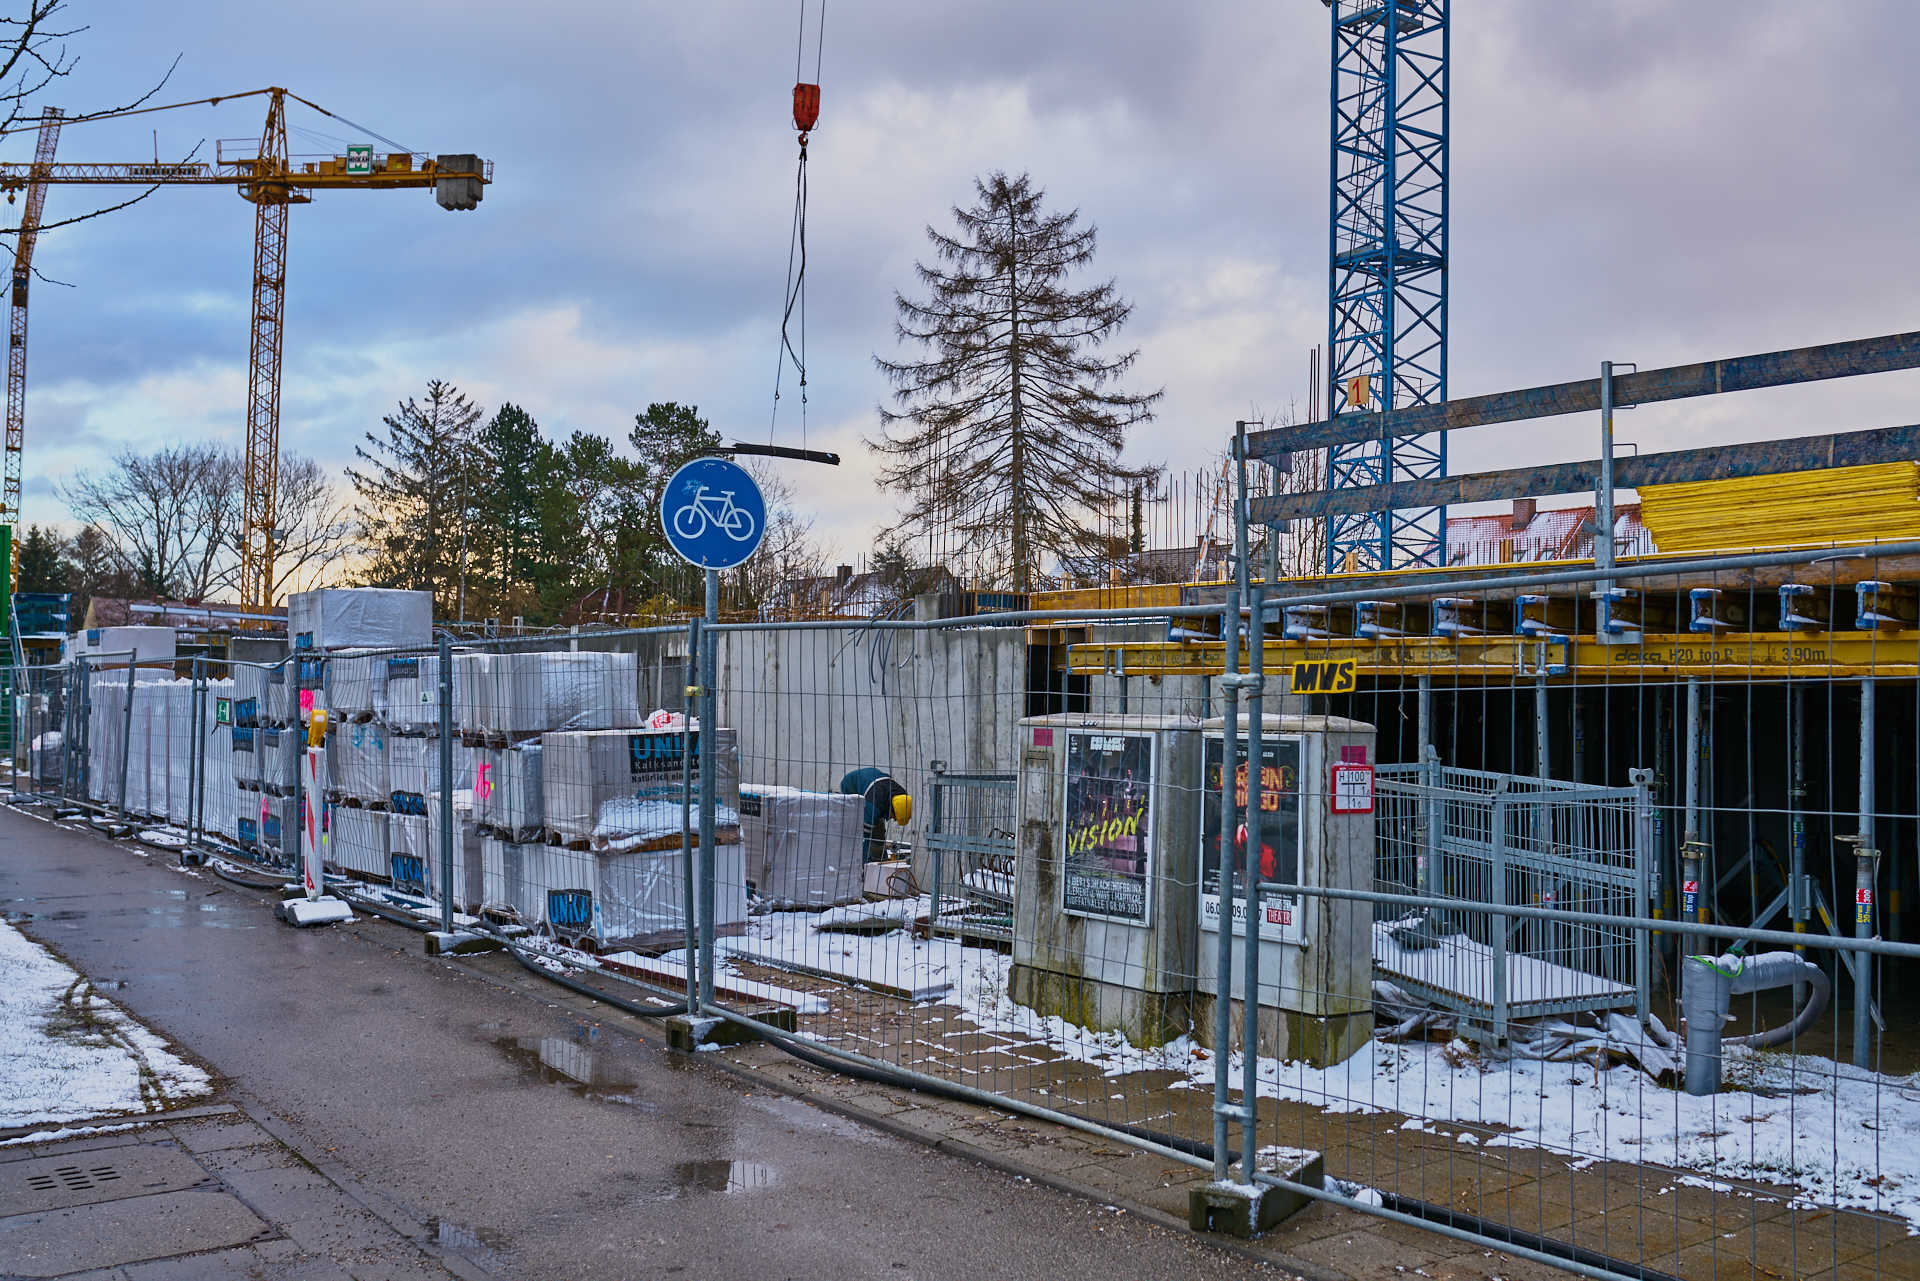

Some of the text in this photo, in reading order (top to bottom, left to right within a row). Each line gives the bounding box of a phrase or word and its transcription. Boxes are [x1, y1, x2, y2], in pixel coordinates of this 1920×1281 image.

[1352, 379, 1361, 404] 1
[1615, 649, 1661, 662] doka
[1669, 648, 1694, 662] H20
[1699, 649, 1720, 663] top
[1724, 648, 1733, 662] P
[1782, 647, 1826, 662] 3.90m
[1294, 661, 1354, 691] MVS
[631, 773, 668, 783] Natürlich
[1339, 771, 1365, 782] H 100
[1067, 807, 1144, 857] VISION
[1863, 889, 1871, 903] 300
